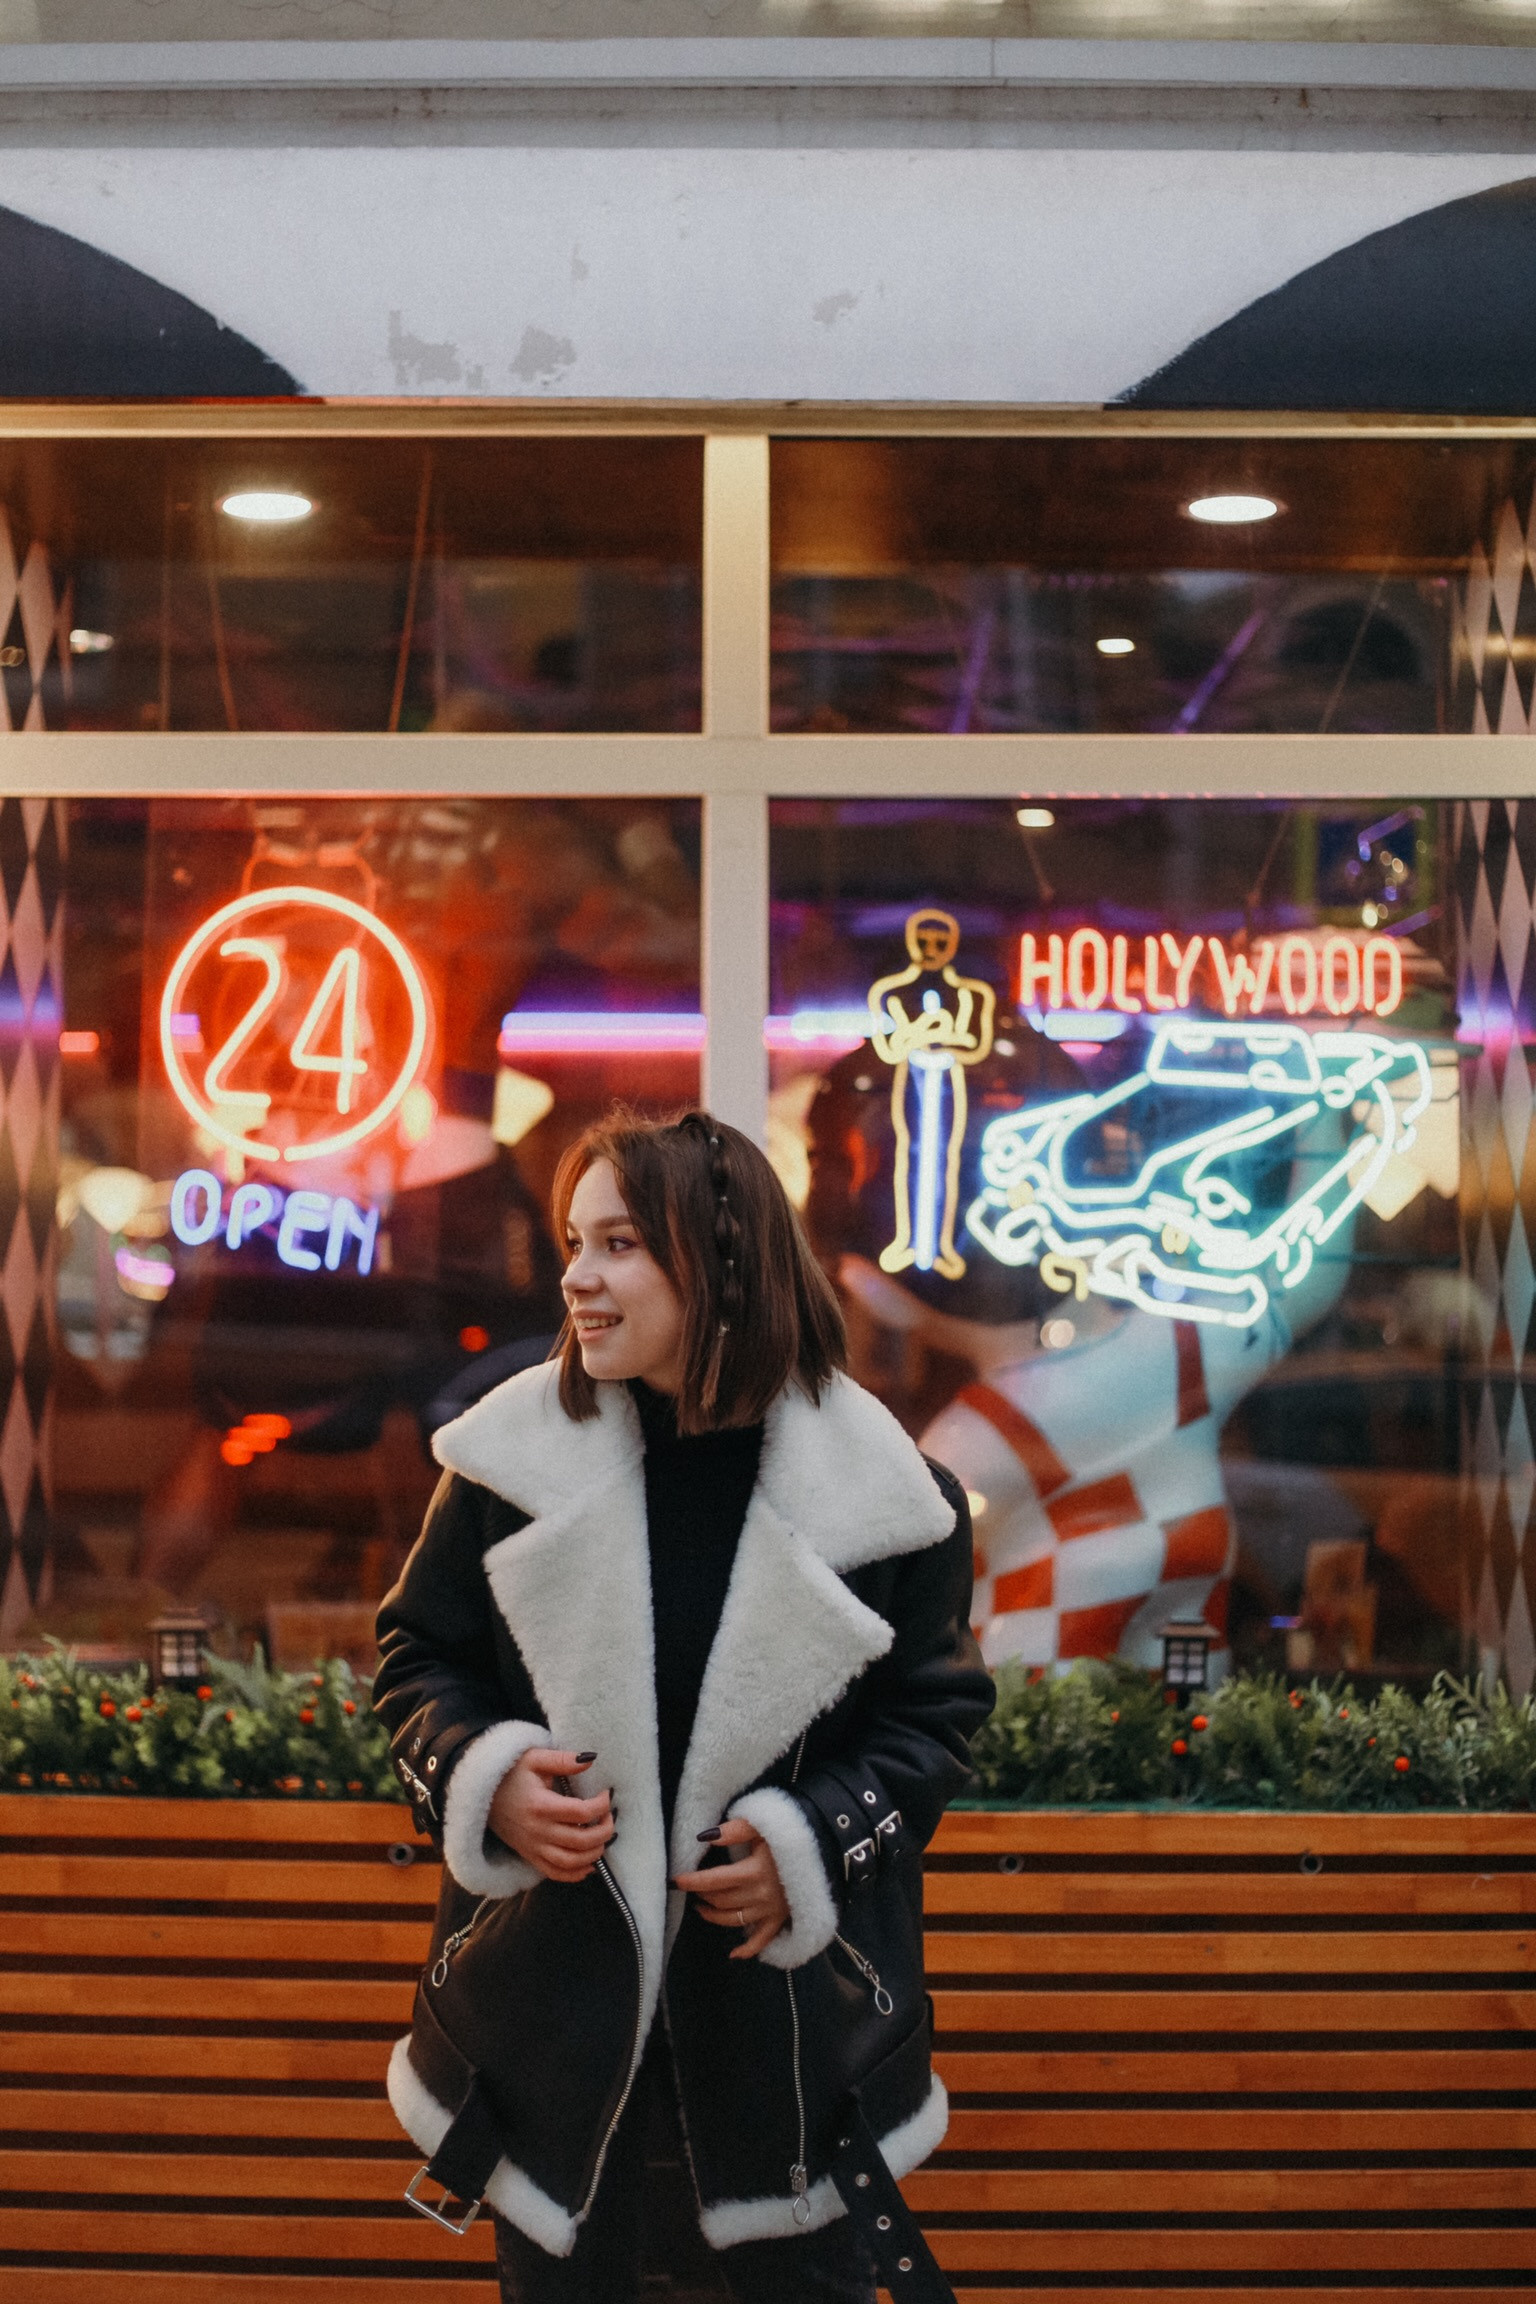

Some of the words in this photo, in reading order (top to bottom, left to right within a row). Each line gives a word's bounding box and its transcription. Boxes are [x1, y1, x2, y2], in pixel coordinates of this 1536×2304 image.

[1020, 928, 1402, 1016] HOLLYWOOD
[204, 938, 368, 1115] 24
[170, 1168, 379, 1276] OPEN
